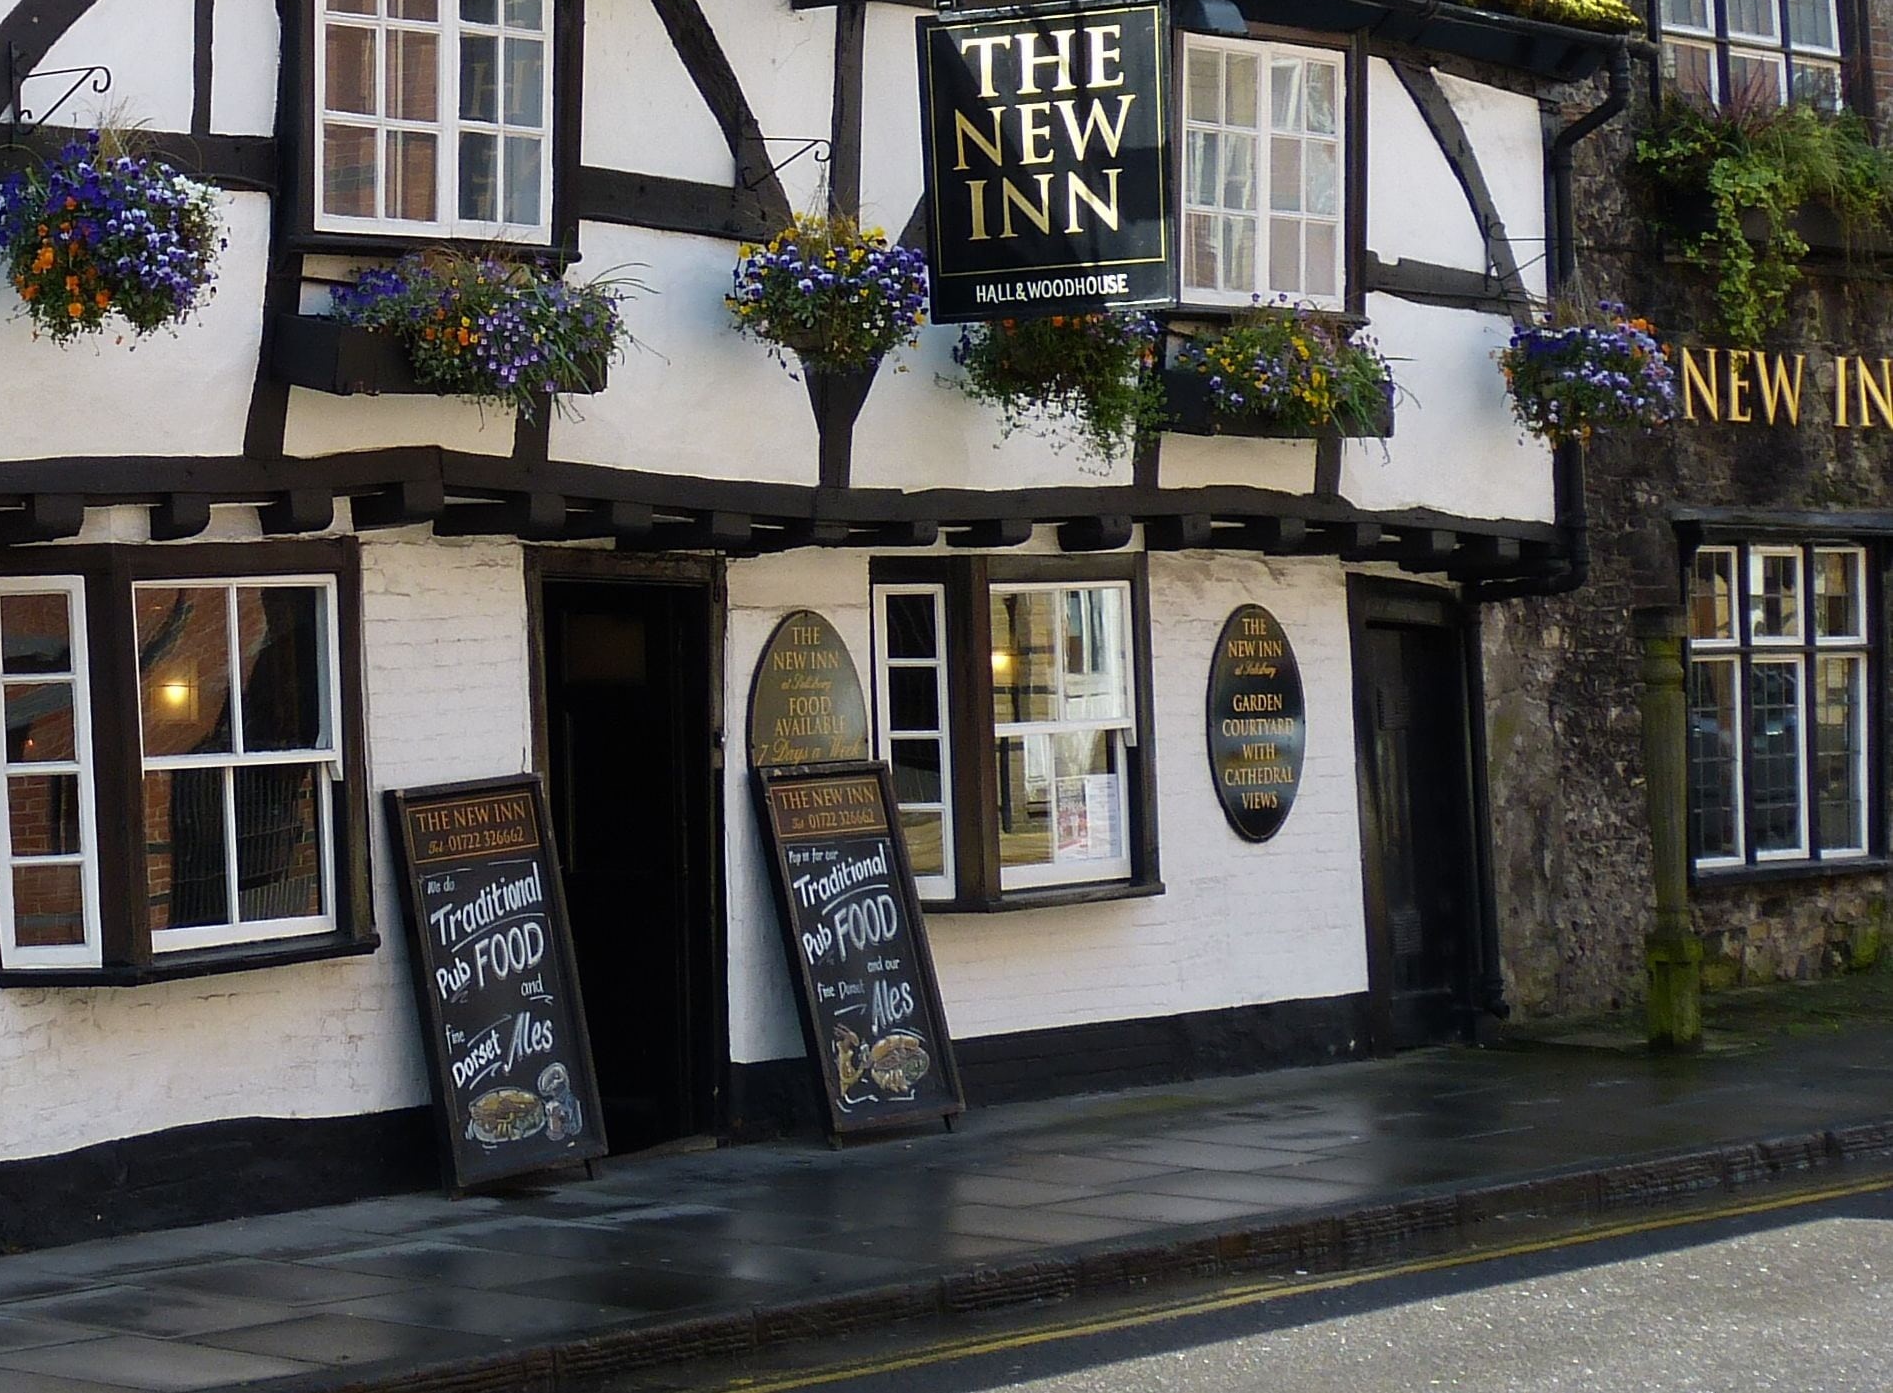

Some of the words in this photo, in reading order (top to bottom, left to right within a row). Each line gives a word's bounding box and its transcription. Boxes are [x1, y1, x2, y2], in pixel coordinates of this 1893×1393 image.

[961, 23, 1126, 99] THE
[952, 93, 1137, 171] NEW
[964, 167, 1123, 242] INN
[1681, 346, 1806, 427] NEW
[792, 626, 821, 645] THE
[1242, 618, 1267, 635] THE
[773, 651, 806, 671] NEW
[811, 650, 840, 669] INN
[1228, 640, 1255, 658] NEW
[1258, 640, 1282, 657] INN
[789, 696, 832, 717] FOOD
[1233, 693, 1283, 712] GARDEN
[774, 715, 846, 737] AVAILABLE
[1222, 717, 1294, 737] COURTYARD
[757, 744, 770, 765] 7
[772, 737, 806, 765] Days
[1242, 743, 1275, 760] WITH
[1225, 766, 1294, 786] CATHEDRAL
[780, 791, 810, 809] THE
[811, 788, 843, 807] NEW
[847, 786, 875, 804] INN
[1241, 790, 1278, 810] VIEWS
[416, 811, 451, 833] THE
[453, 805, 489, 828] NEW
[494, 801, 526, 823] INN
[809, 812, 837, 828] 01722
[839, 809, 875, 825] 326662
[448, 833, 481, 851] 01722
[484, 826, 524, 847] 326662
[793, 842, 888, 908] Traditional
[430, 861, 543, 946] Traditional
[802, 926, 832, 965] Pub
[834, 894, 899, 962] FOOD
[436, 957, 471, 1000] Pub
[474, 921, 545, 989] FOOD
[867, 955, 883, 973] and
[521, 972, 544, 996] and
[872, 979, 914, 1036] Ales
[452, 1029, 501, 1088] Dorset
[504, 1011, 554, 1073] Ales
